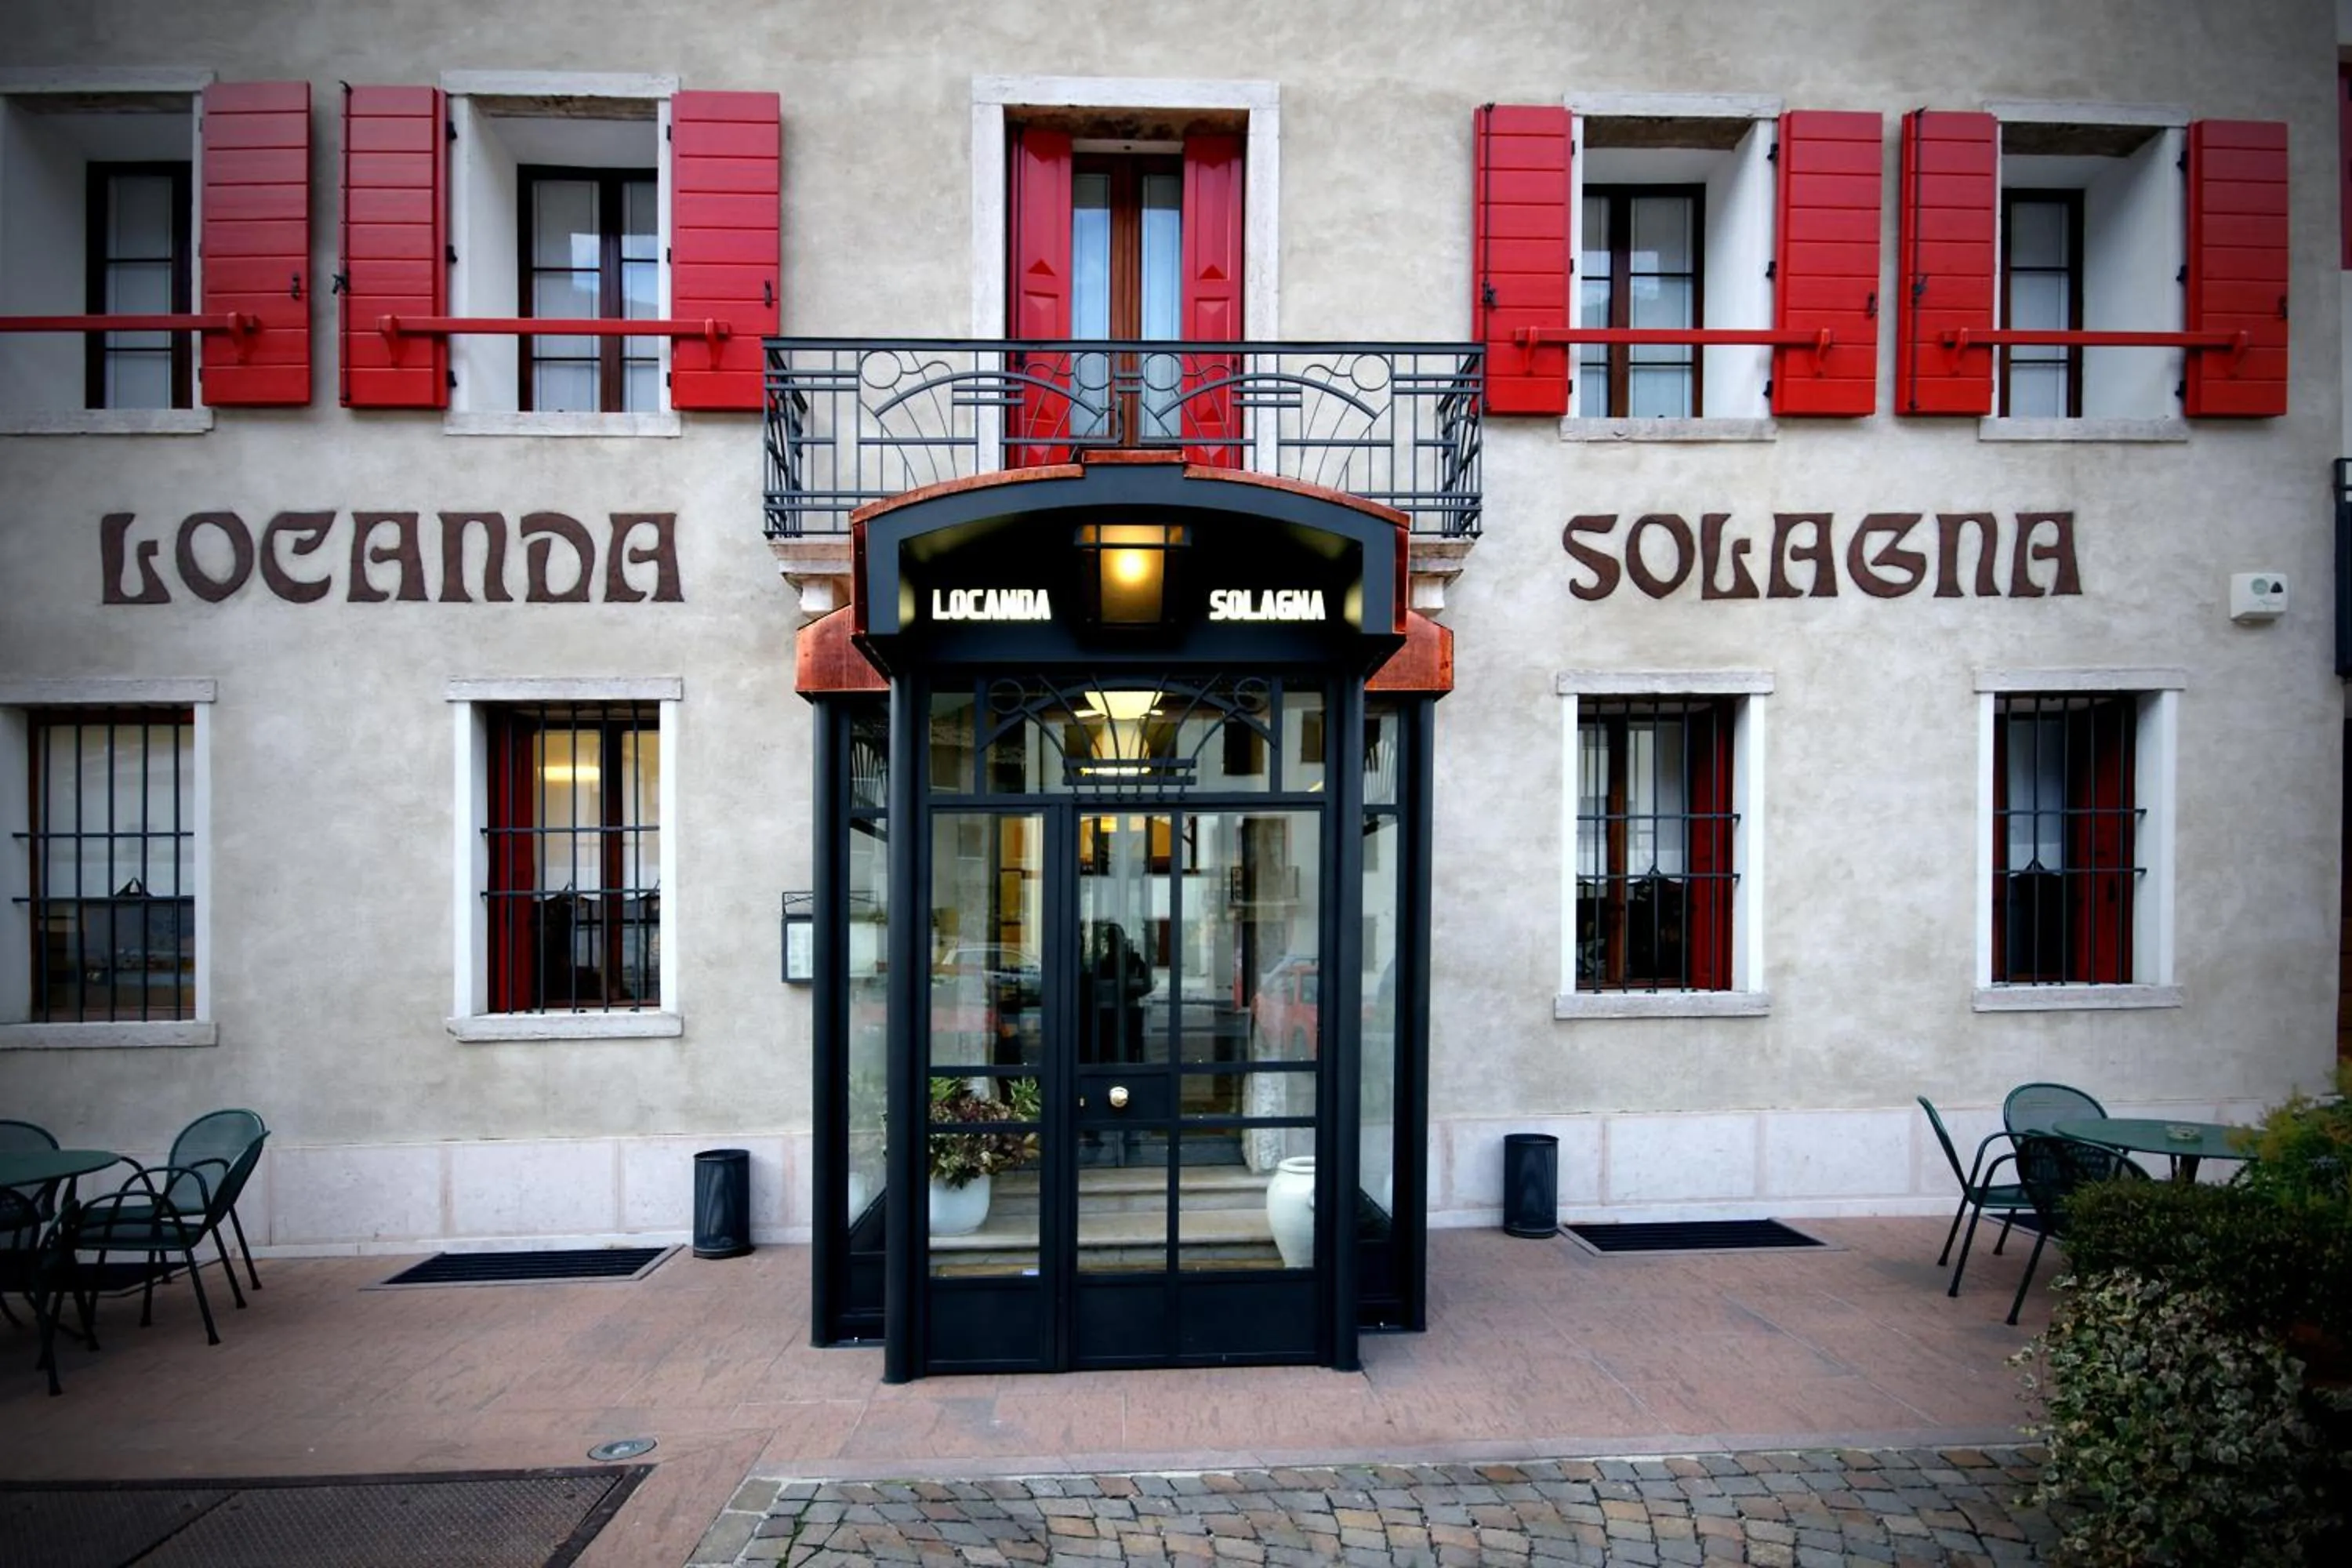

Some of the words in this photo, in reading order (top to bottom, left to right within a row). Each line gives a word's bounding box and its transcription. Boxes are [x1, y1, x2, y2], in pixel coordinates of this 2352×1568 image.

[101, 511, 684, 604] LOCANDA
[1563, 511, 2083, 601] SOLAGNA
[932, 589, 1051, 620] LOCANDA
[1209, 589, 1326, 620] SOLAGNA
